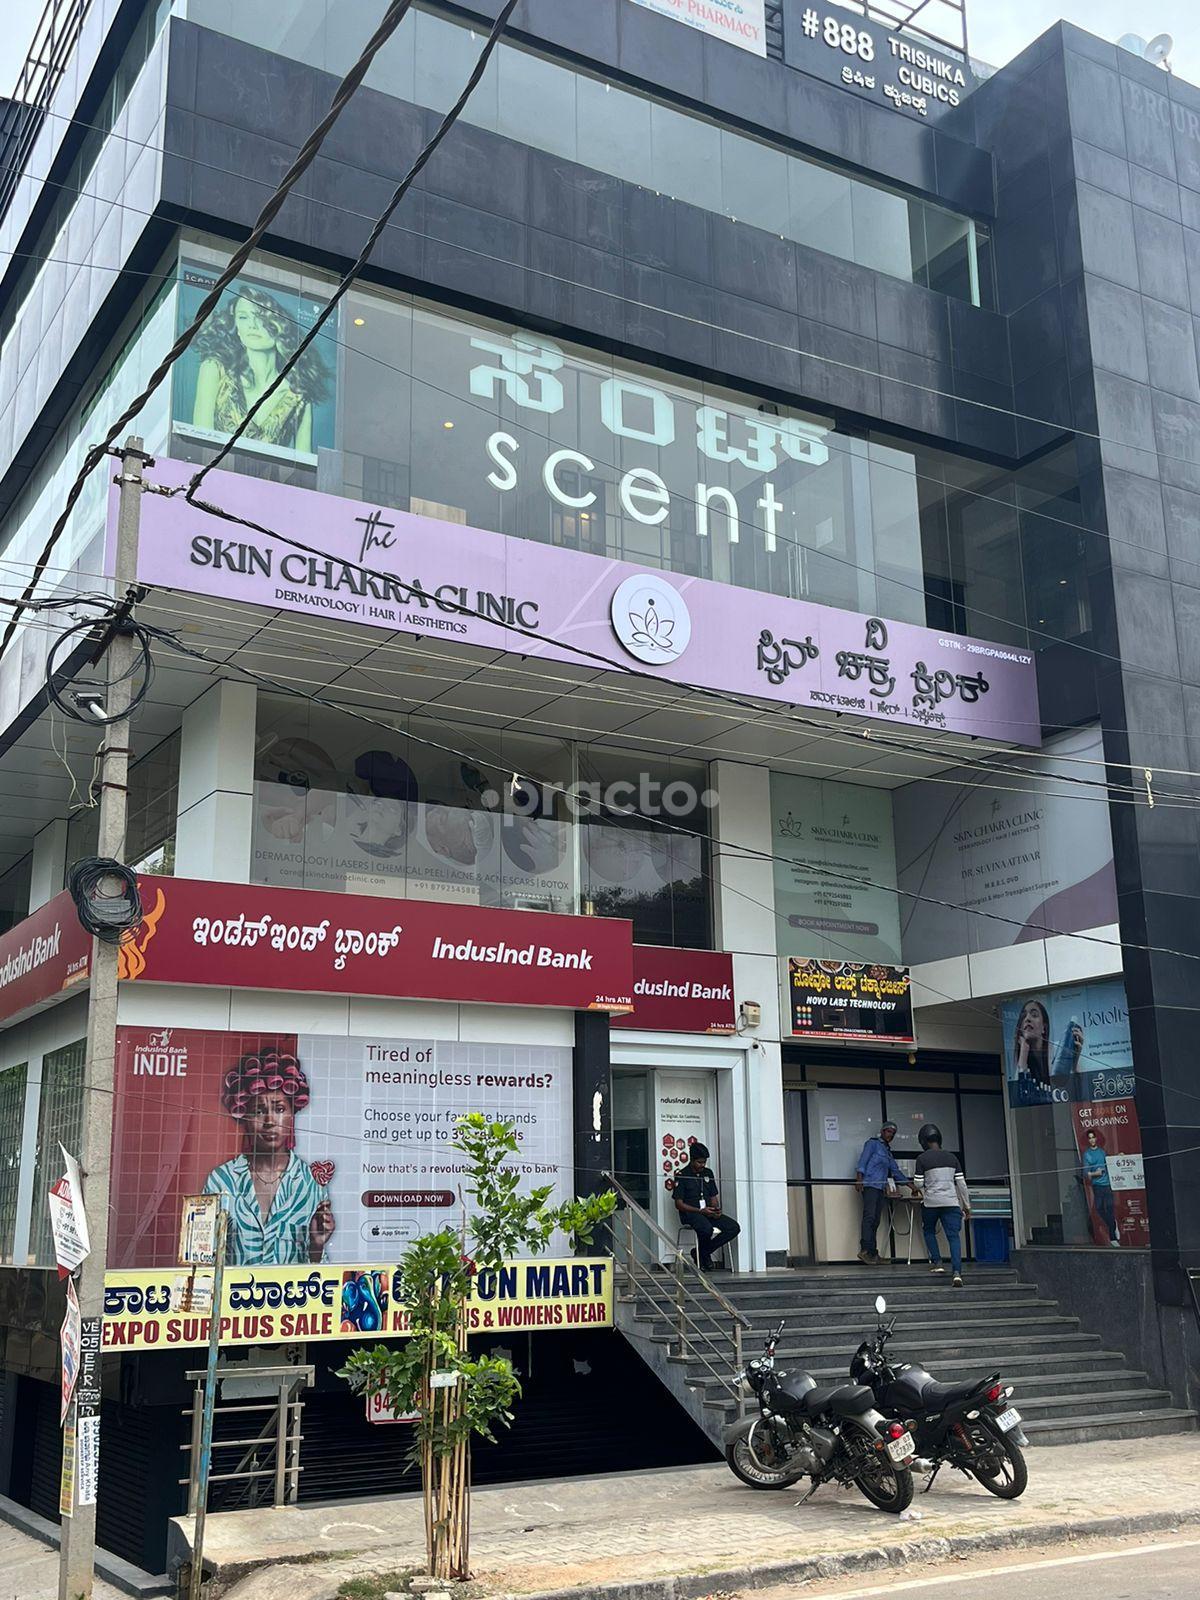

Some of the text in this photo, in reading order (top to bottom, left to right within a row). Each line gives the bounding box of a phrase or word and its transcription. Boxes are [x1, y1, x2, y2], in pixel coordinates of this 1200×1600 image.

[688, 2, 759, 41] PHARMACY
[888, 36, 966, 88] TRISHIKA
[899, 66, 960, 106] CUBICS
[354, 509, 400, 563] the
[190, 534, 541, 630] SKIN CHAKRA CLINIC
[275, 588, 468, 634] DERMATOLOGY HAIR AESTHETICS
[865, 616, 888, 651] ದಿ
[757, 628, 990, 710] ಸ್ಕಿನ್ ಚಕ್ರ ಕ್ಲಿನಿಕ್
[254, 850, 329, 867] DERMATOLOGY
[335, 859, 370, 871] LASERS
[376, 863, 422, 877] CHEMICAL
[424, 866, 445, 878] PEEL
[451, 869, 475, 882] ACNE
[477, 871, 483, 881] &
[484, 871, 507, 883] ACNE
[509, 873, 534, 887] SCARS
[541, 877, 569, 890] BOTOX
[0, 922, 62, 988] ndusInd Bank
[334, 925, 403, 970] ಬ್ಯಾಂಕ್
[432, 937, 593, 971] IndusInd Bank
[595, 994, 632, 1005] 24 hrs ATM
[634, 979, 732, 1001] dusInd Bank
[806, 995, 896, 1011] NOVO LABS TECHNOLOGY
[135, 1045, 187, 1054] IndusInd Bank
[366, 1045, 432, 1064] Tired of
[133, 1053, 188, 1077] INDIE
[365, 1067, 553, 1088] meaningless rewards?
[686, 1097, 702, 1105] Bank
[1079, 1107, 1092, 1118] GET
[1115, 1104, 1126, 1114] ON
[364, 1108, 411, 1123] Choose
[415, 1111, 442, 1124] your
[496, 1111, 537, 1124] brands
[1080, 1115, 1128, 1128] YOUR SAVINGS
[363, 1127, 388, 1140] and
[391, 1128, 412, 1142] get
[416, 1130, 432, 1142] up
[435, 1129, 448, 1140] to
[362, 1164, 385, 1174] Now
[388, 1163, 418, 1174] that's
[421, 1166, 427, 1174] a
[499, 1165, 519, 1176] way
[522, 1165, 532, 1174] to
[535, 1164, 558, 1174] bank
[373, 1194, 443, 1203] DOWNLOAD NOW
[381, 1228, 409, 1237] App Store
[229, 1271, 340, 1311] ಮಾರ್ಟ್
[525, 1263, 606, 1300] MART
[483, 1310, 495, 1328] &
[497, 1305, 564, 1327] WOMENS
[566, 1302, 606, 1323] WEAR
[103, 1312, 333, 1346] EXPO SURPLUS SALE
[80, 1337, 99, 1348] 05
